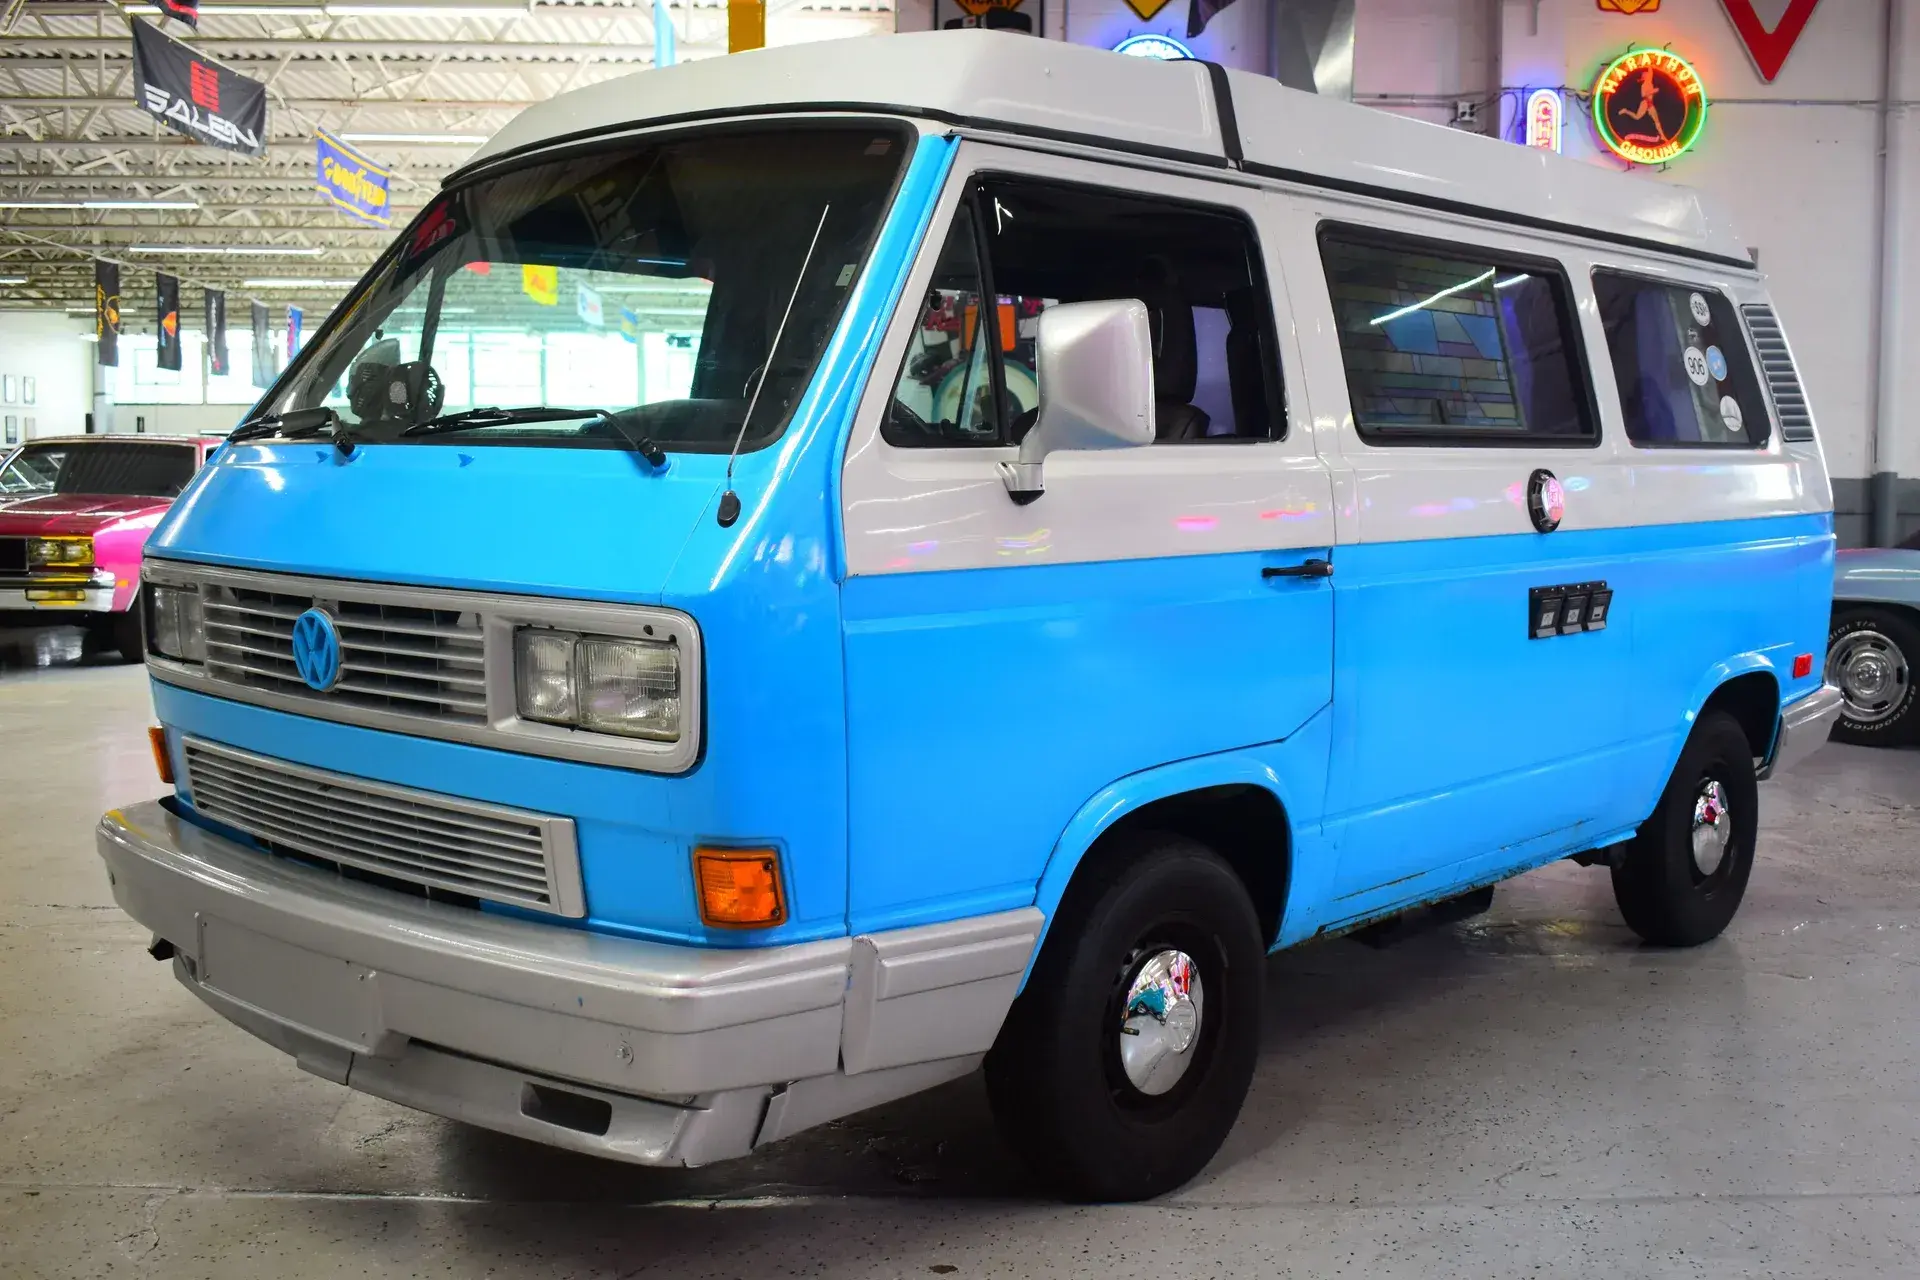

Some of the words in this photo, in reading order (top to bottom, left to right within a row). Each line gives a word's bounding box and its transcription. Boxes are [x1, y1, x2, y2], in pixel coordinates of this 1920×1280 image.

[1603, 53, 1700, 94] MARATHON
[1620, 141, 1681, 159] GASOLINE
[1687, 357, 1706, 376] 906
[1856, 620, 1877, 628] T/A
